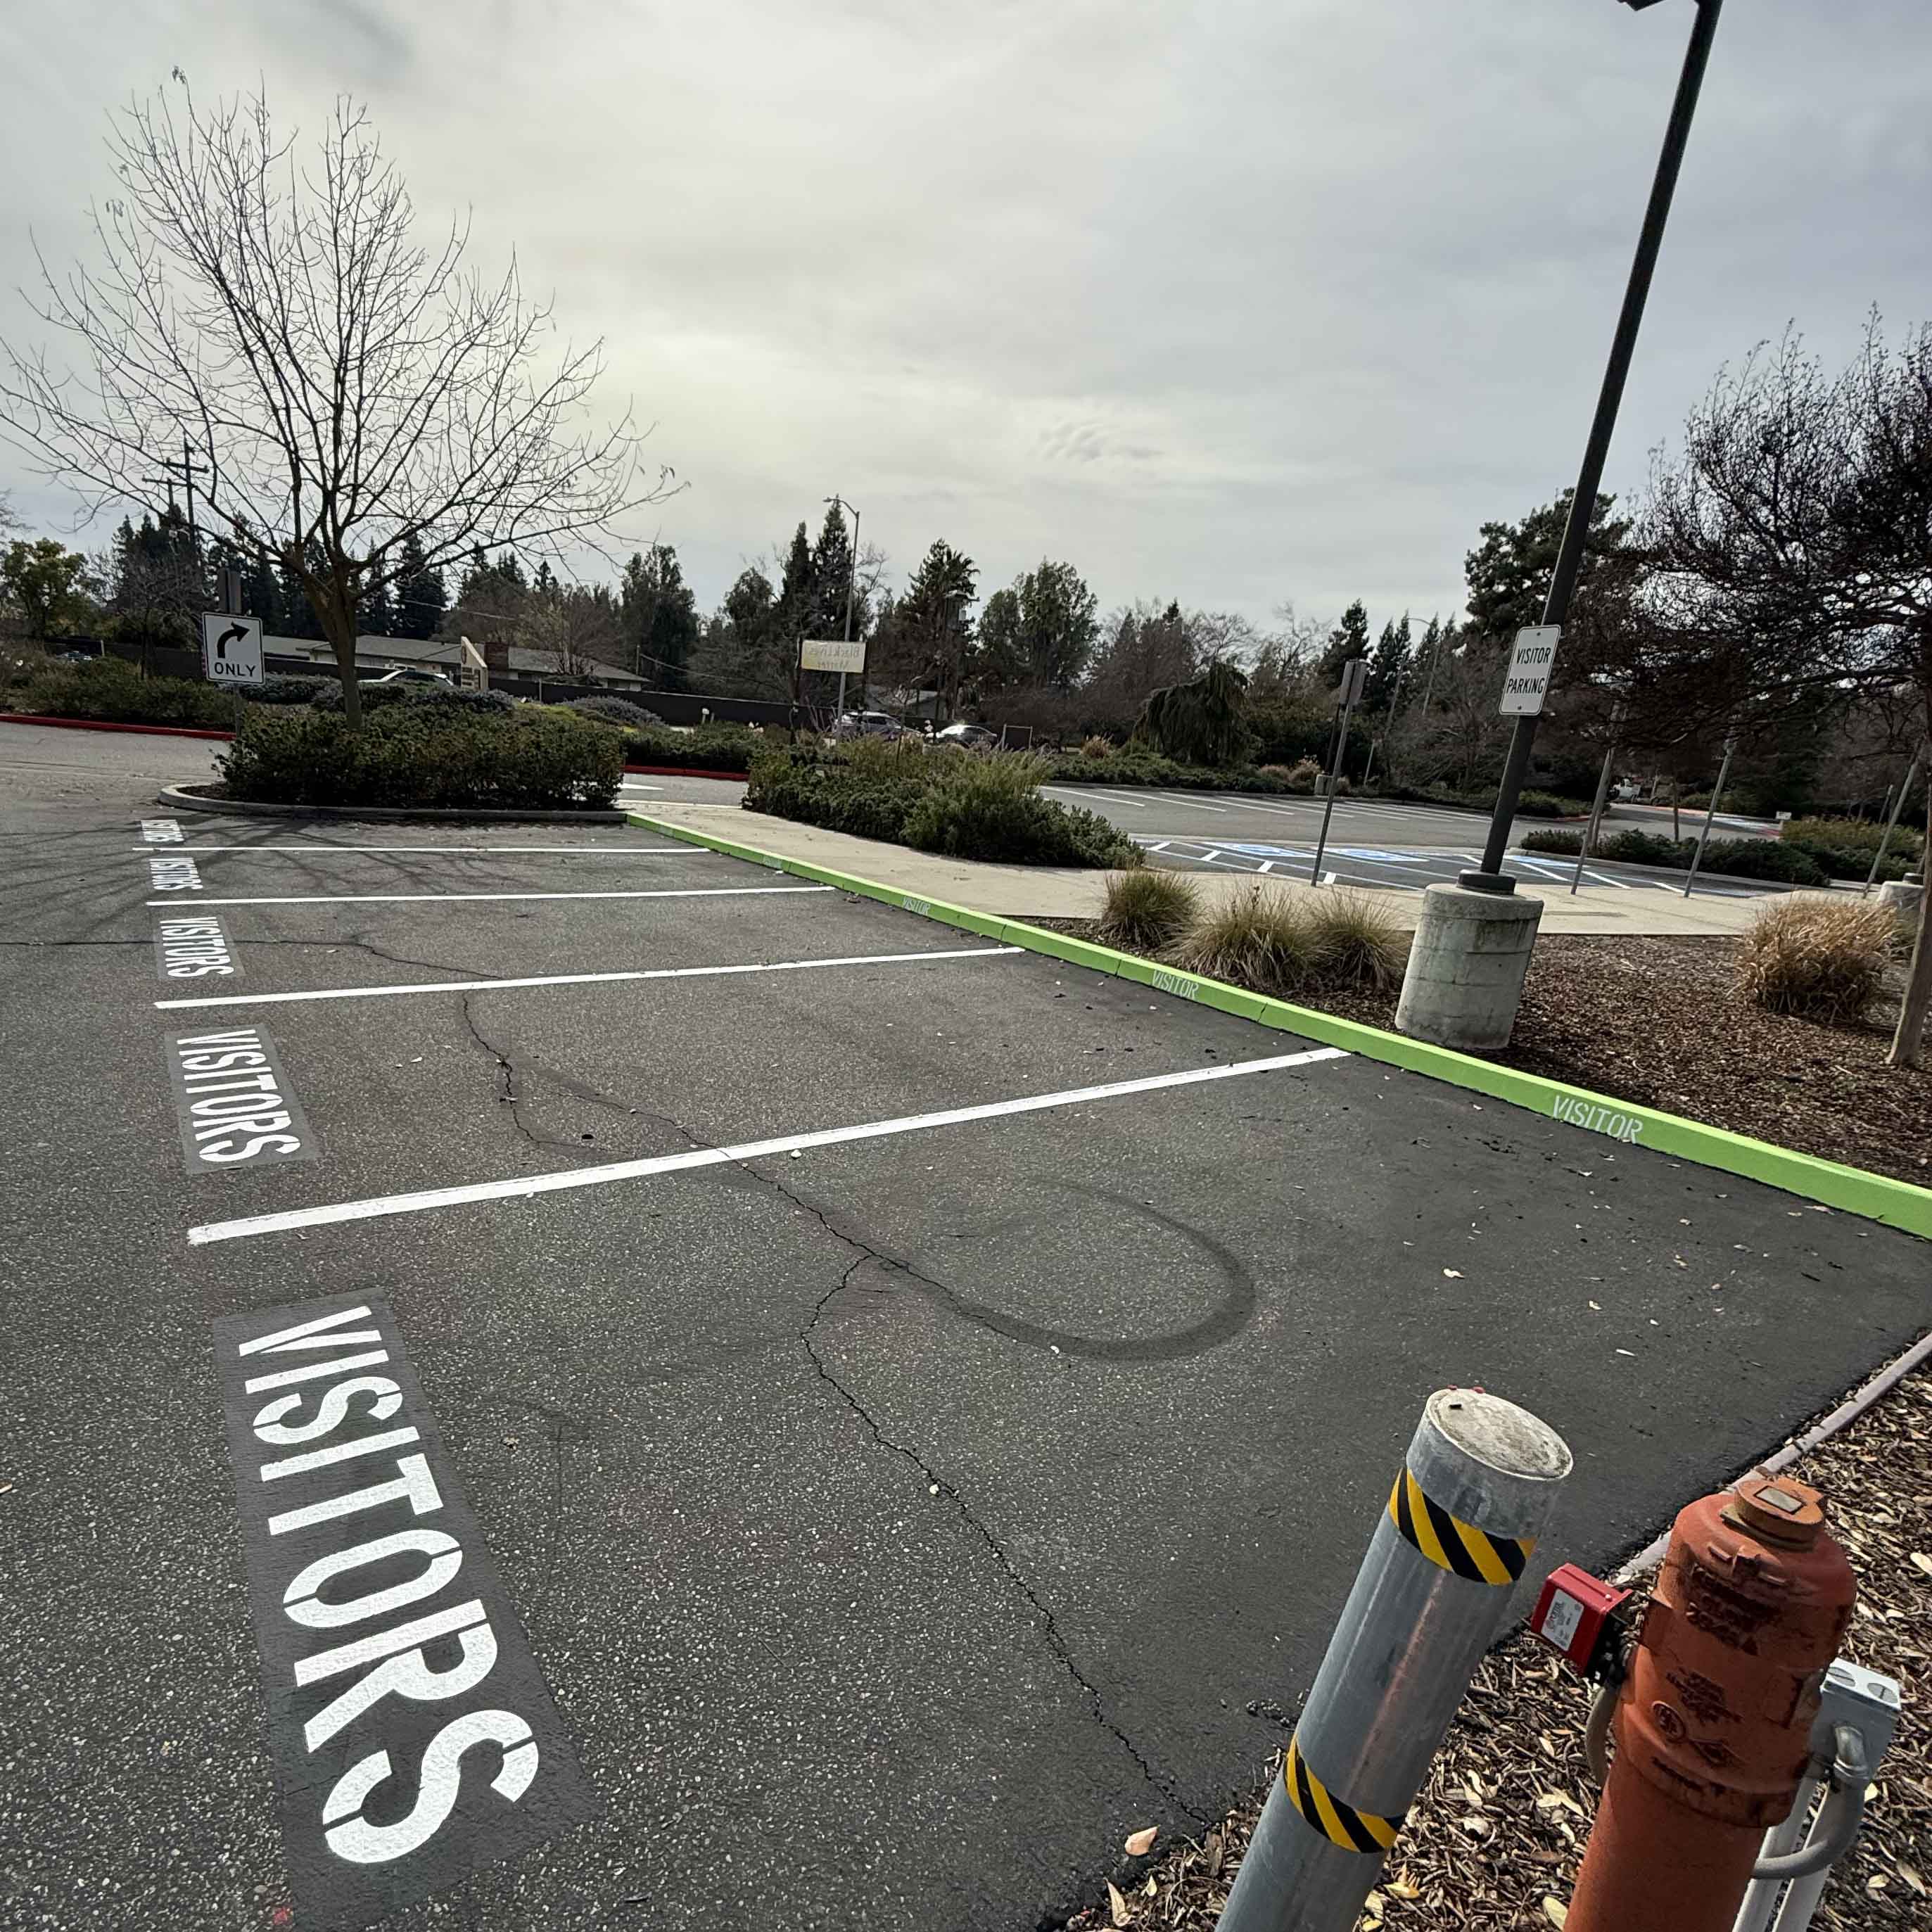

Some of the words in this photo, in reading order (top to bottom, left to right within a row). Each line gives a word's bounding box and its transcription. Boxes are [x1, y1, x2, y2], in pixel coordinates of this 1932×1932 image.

[214, 661, 256, 677] ONLY
[1516, 647, 1551, 664] VISITOR
[1506, 678, 1545, 694] PARKING
[149, 857, 203, 890] VISITORS
[160, 917, 234, 977] VISITORS
[1152, 970, 1200, 1000] VISITOR
[177, 1029, 301, 1162] VISITORS
[1552, 1095, 1644, 1144] VISITOR
[238, 1305, 539, 1864] VISITORS
